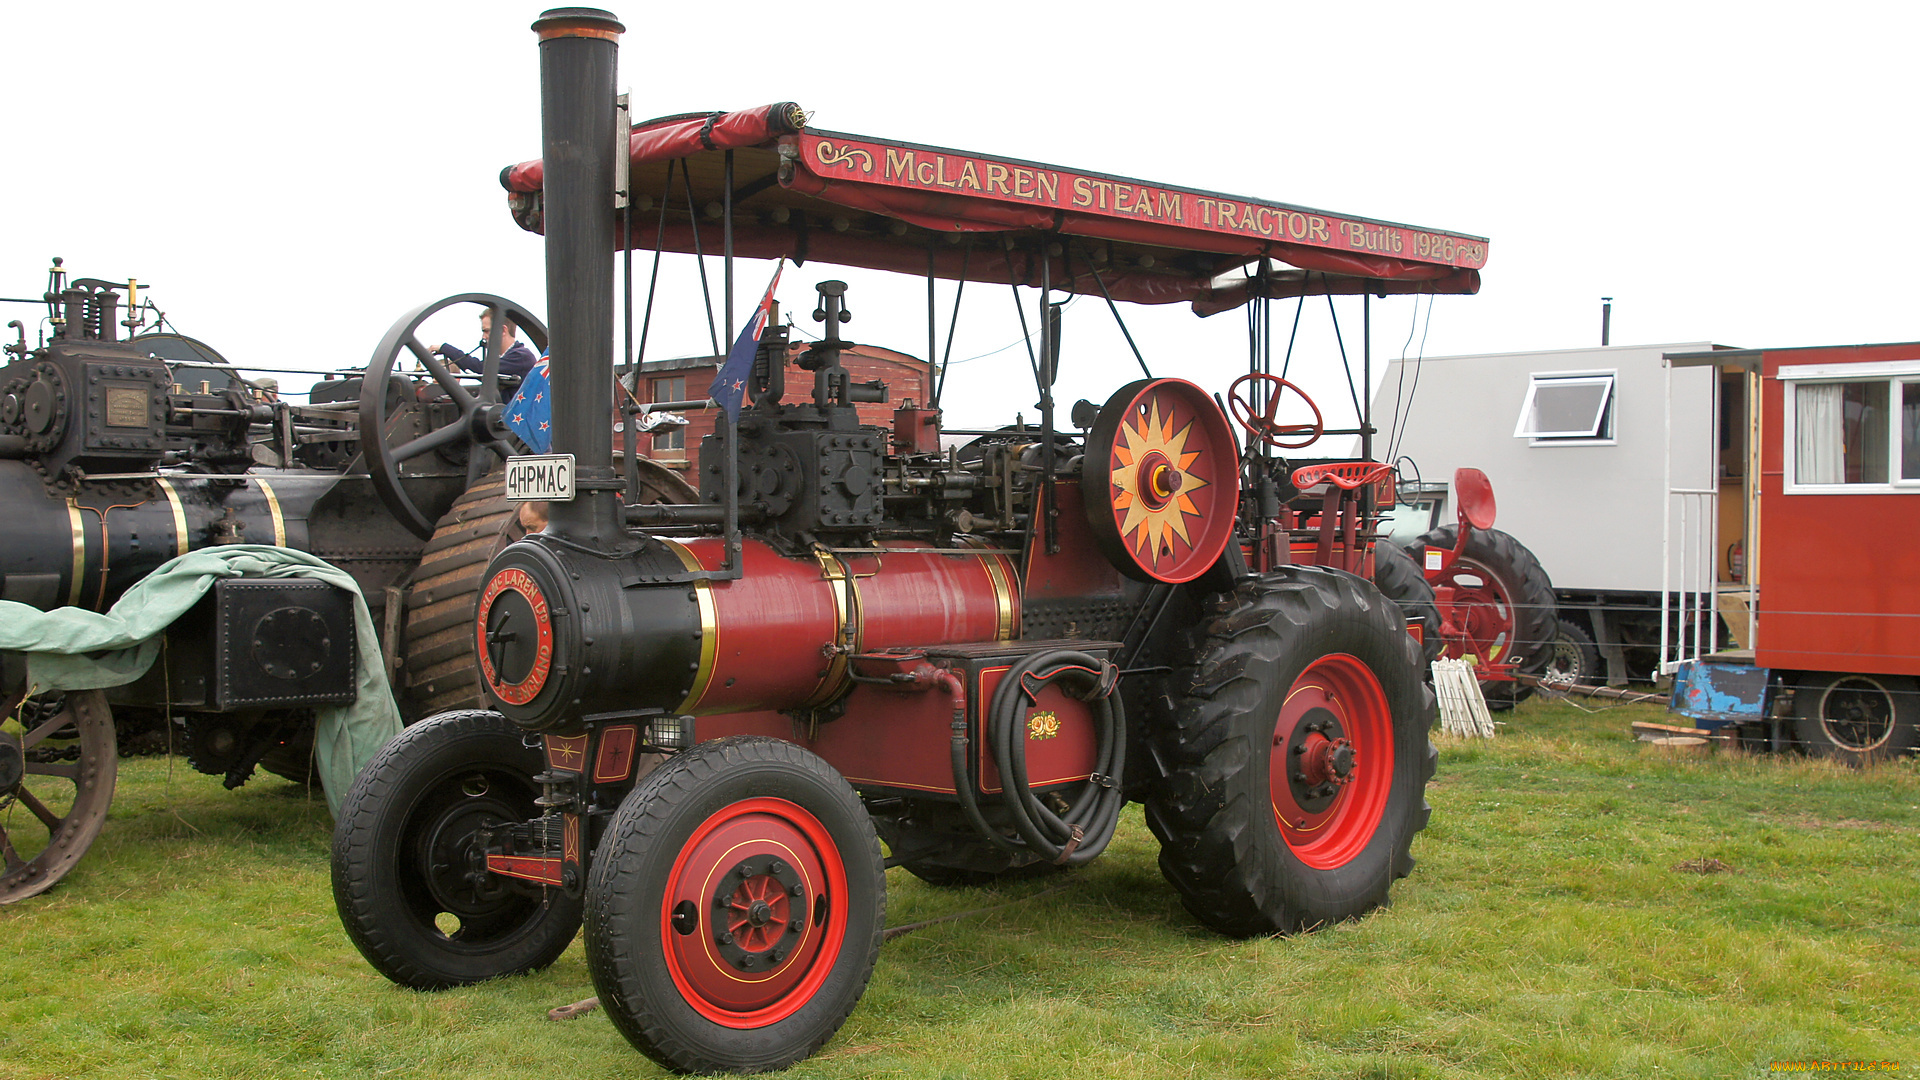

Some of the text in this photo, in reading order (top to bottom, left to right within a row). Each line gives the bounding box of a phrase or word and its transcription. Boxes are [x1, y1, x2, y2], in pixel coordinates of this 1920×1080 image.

[885, 147, 1454, 262] McLAREN STEAM TRACTOR Built 1926
[509, 464, 567, 493] 4HPMAC
[515, 645, 550, 702] ENGLAND
